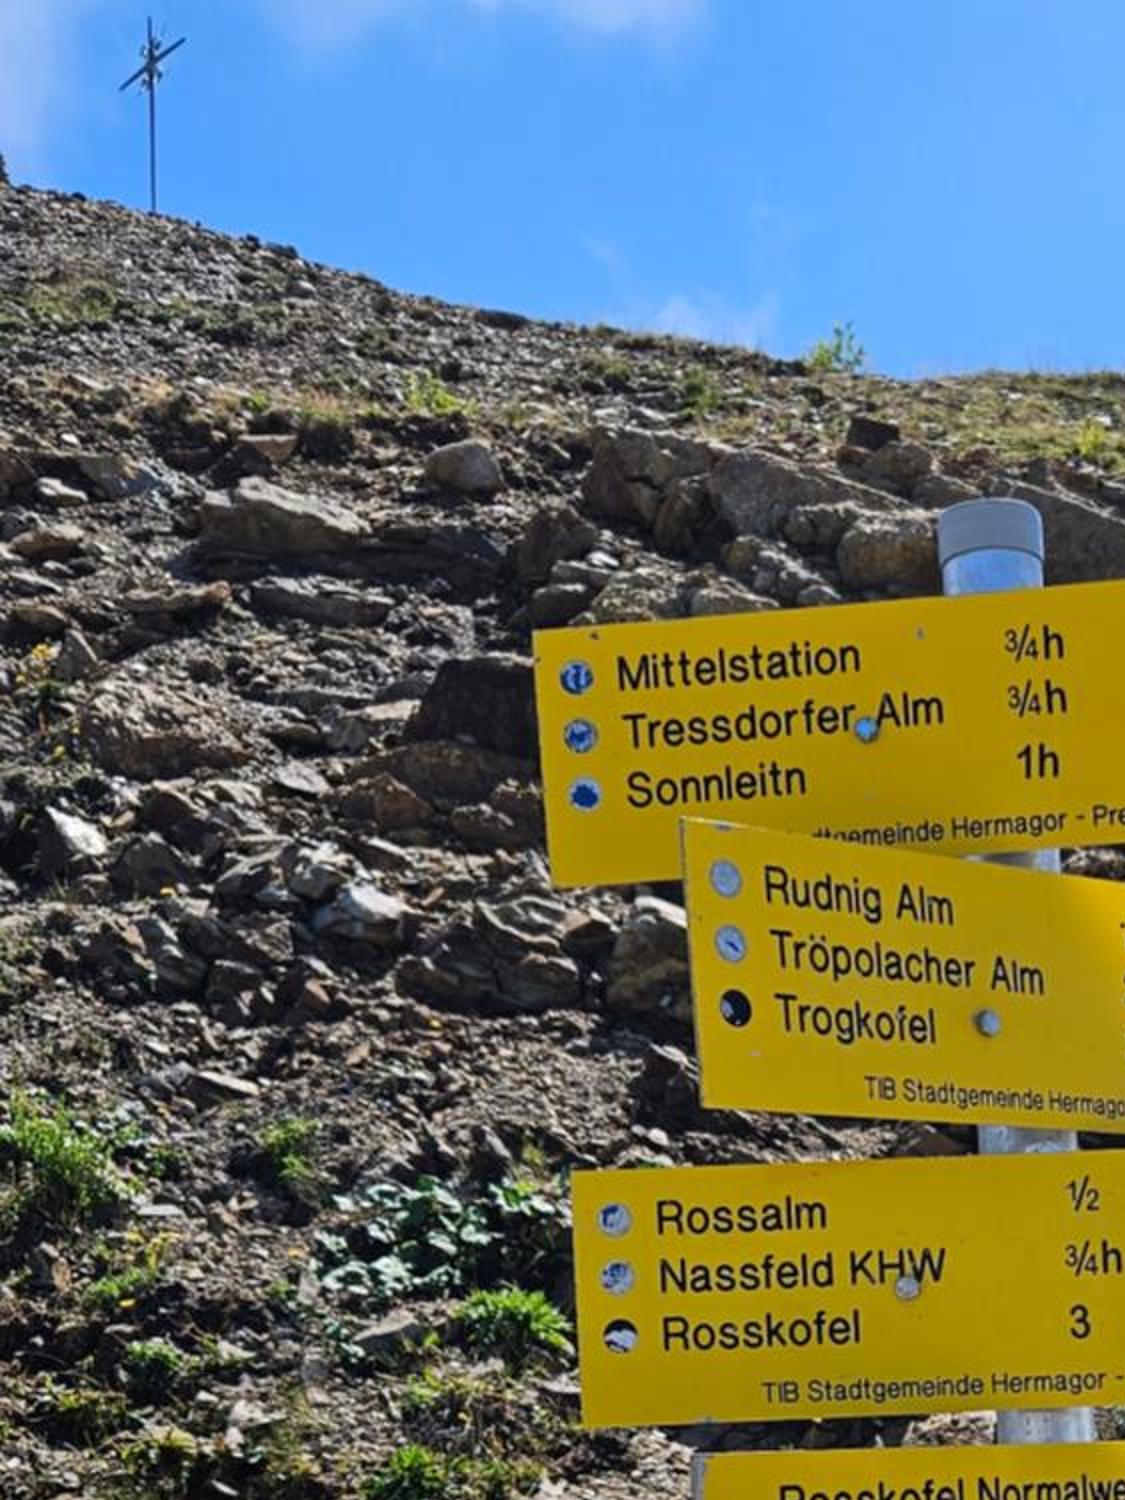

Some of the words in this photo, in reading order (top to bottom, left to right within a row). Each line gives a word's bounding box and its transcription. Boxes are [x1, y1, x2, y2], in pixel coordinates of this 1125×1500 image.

[617, 641, 861, 691] Mittelstation
[622, 699, 856, 749] Tressdorfer
[876, 692, 944, 726] Alm
[1017, 743, 1060, 779] 1h
[627, 761, 806, 809] Sonnleitn
[951, 813, 1067, 839] Hermagor
[764, 864, 882, 925] Rudnig
[896, 883, 954, 926] Alm
[769, 929, 976, 988] Tröpolacher
[991, 956, 1044, 995] Alm
[774, 992, 936, 1046] Trogkofel
[863, 1075, 897, 1101] TIB
[902, 1078, 1044, 1111] Stadtgemeinde
[656, 1196, 827, 1235] Rossalm
[660, 1252, 834, 1293] Nassfeld
[849, 1247, 945, 1285] KHW
[663, 1309, 860, 1351] Rosskofel
[1070, 1304, 1091, 1340] 3
[761, 1380, 800, 1404] TIB
[807, 1375, 985, 1404] Stadtgemeinde
[991, 1372, 1107, 1395] Hermagor
